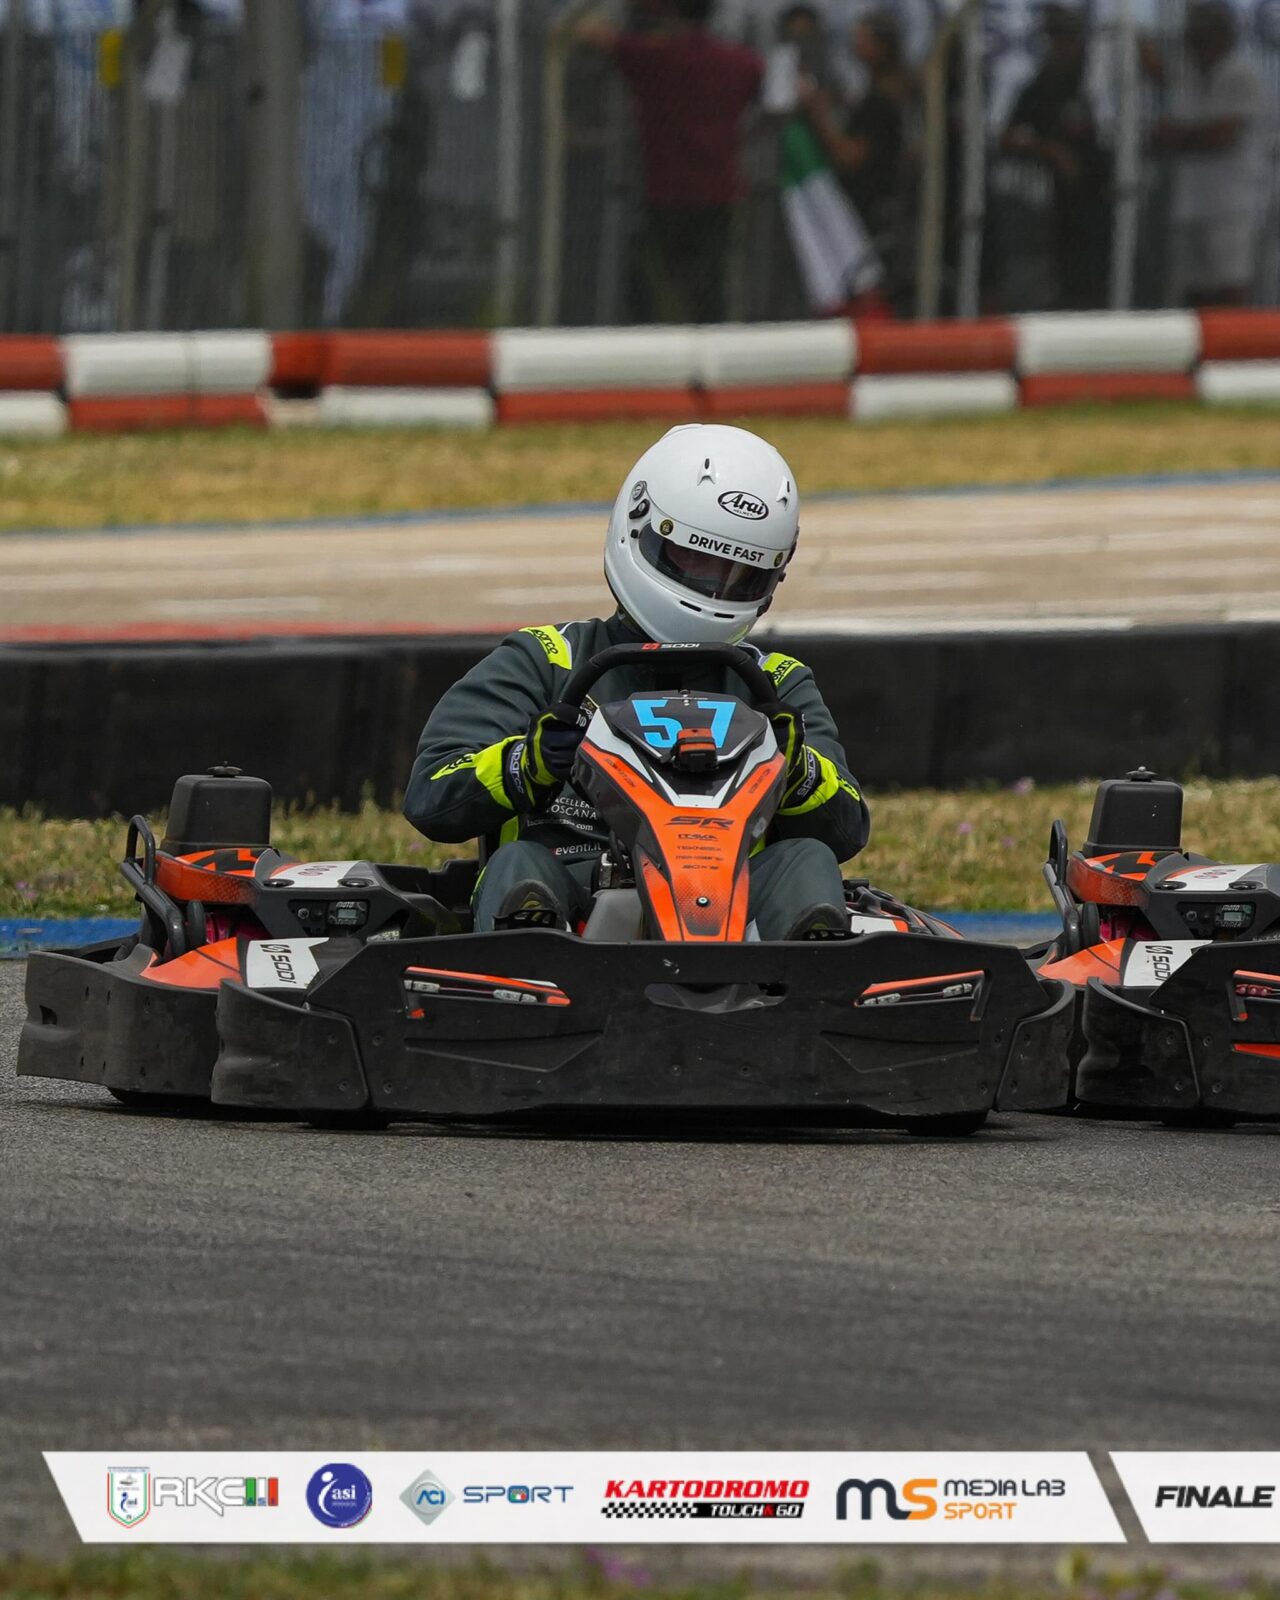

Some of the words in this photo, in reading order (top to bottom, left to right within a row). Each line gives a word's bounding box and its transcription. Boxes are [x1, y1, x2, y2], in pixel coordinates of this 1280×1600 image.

[721, 493, 765, 515] Arai
[688, 533, 733, 555] DRIVE
[732, 546, 765, 563] FAST
[631, 699, 737, 750] 57
[546, 803, 597, 820] OSCANA
[663, 815, 735, 830] SR
[270, 954, 297, 985] SODI
